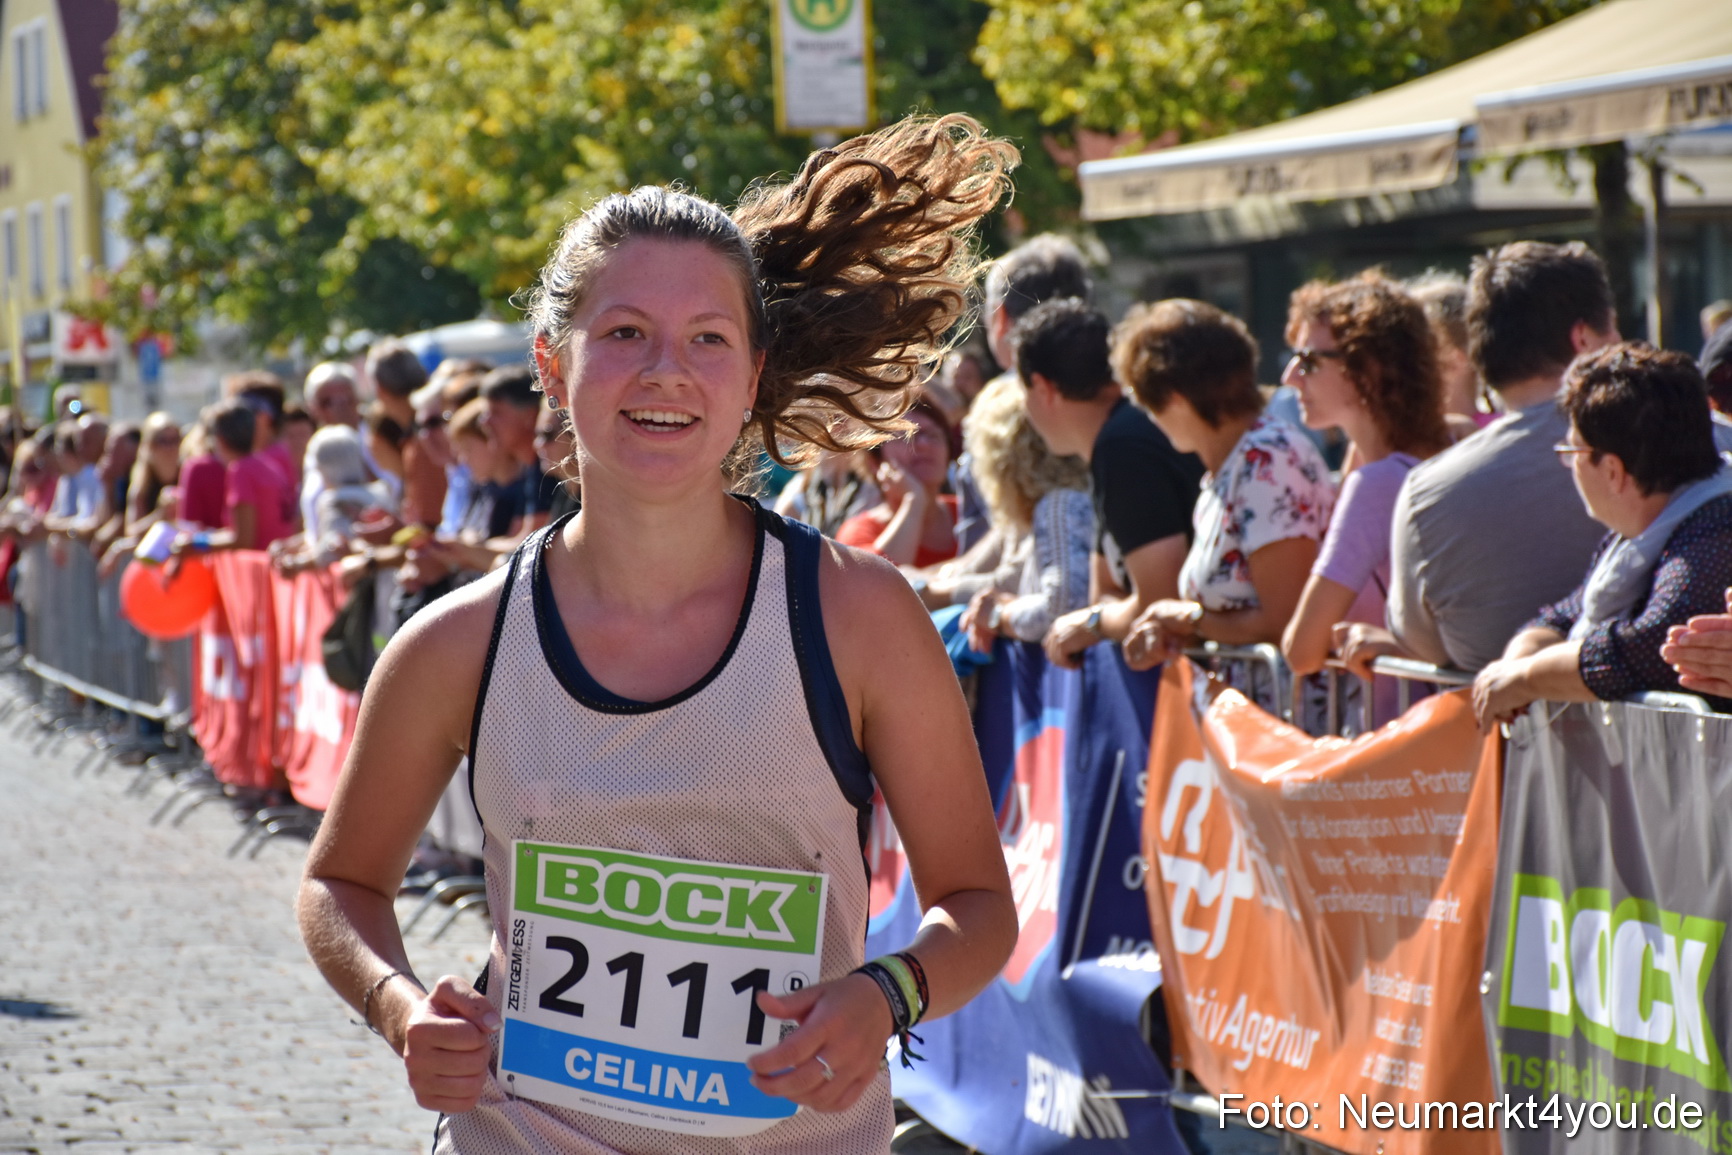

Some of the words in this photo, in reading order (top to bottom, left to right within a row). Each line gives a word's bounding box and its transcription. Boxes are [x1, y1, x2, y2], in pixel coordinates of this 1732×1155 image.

[1411, 768, 1472, 794] Partner
[536, 853, 797, 943] BOCK
[538, 935, 771, 1046] 2111
[1510, 895, 1710, 1065] BOCK
[564, 1047, 730, 1106] CELINA
